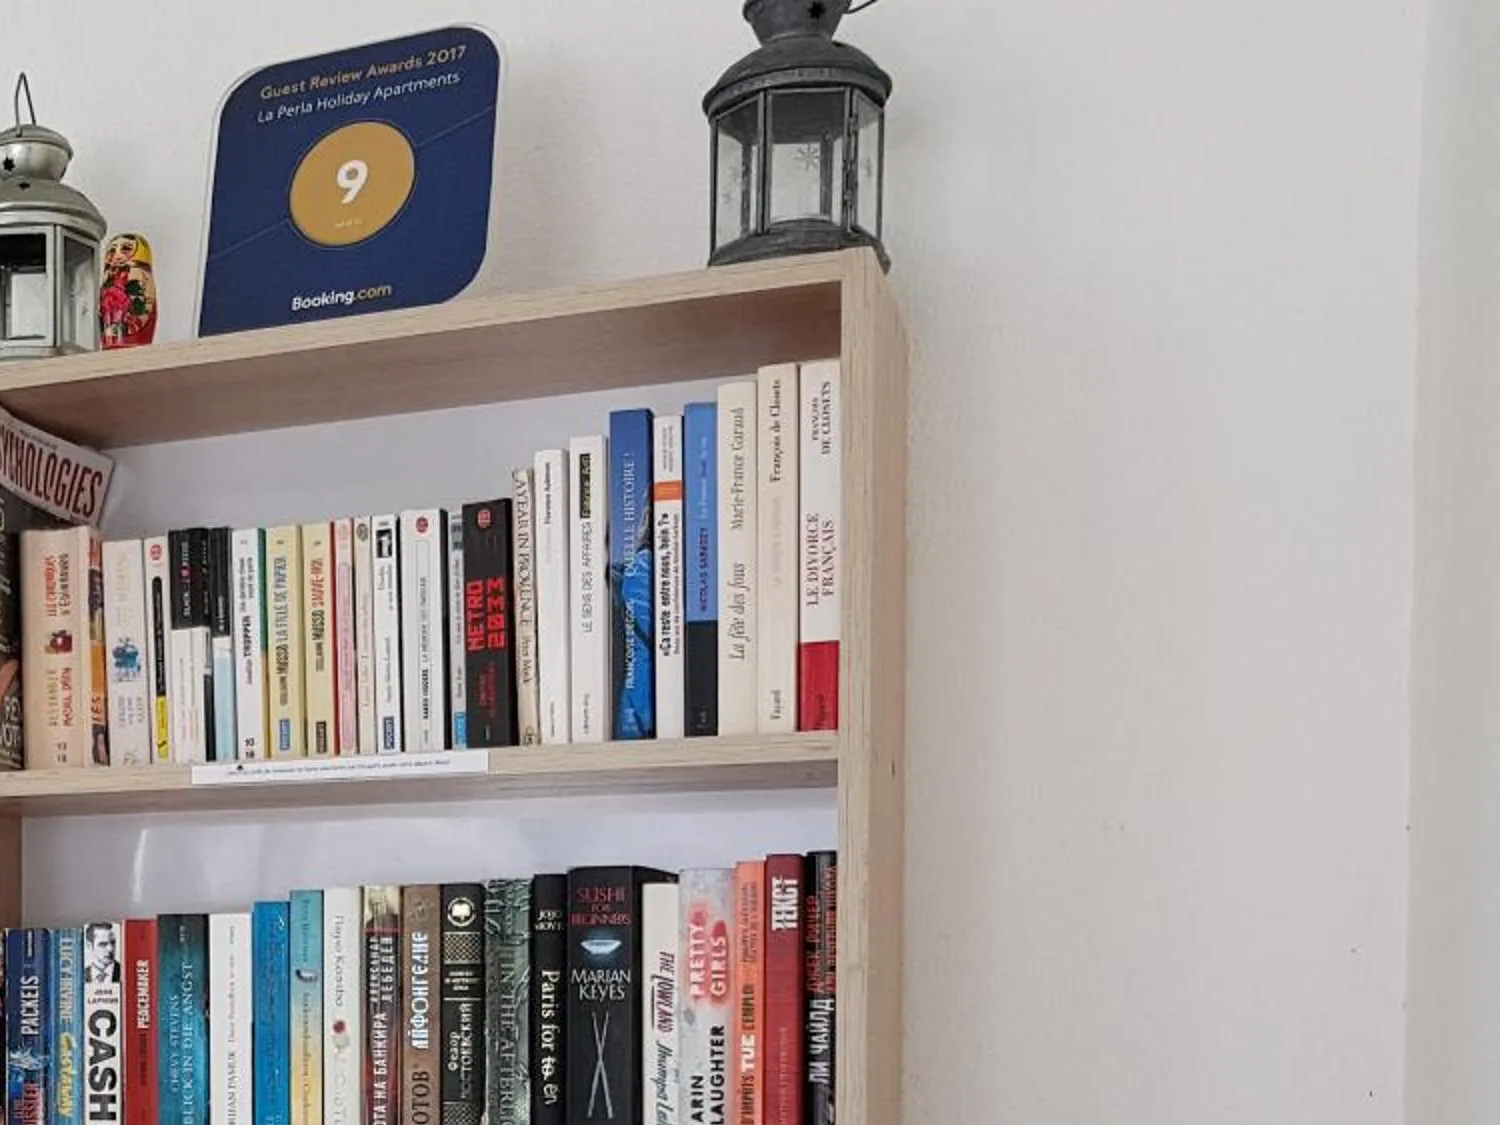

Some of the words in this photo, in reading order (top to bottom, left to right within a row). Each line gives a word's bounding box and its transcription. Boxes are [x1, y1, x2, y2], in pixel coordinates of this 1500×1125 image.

[260, 81, 306, 101] Guest
[309, 69, 363, 90] Review
[367, 56, 423, 78] Awards
[426, 45, 467, 66] 2017
[258, 109, 273, 123] La
[277, 100, 313, 119] Perla
[317, 89, 371, 111] Holiday
[374, 71, 461, 101] Apartments
[336, 159, 368, 205] 9
[291, 284, 392, 311] Booking.com
[769, 378, 781, 418] Closets
[820, 380, 831, 436] CLOSETS
[729, 406, 745, 452] Garaud
[770, 420, 781, 433] de
[820, 437, 831, 455] DE
[769, 435, 784, 483] François
[515, 488, 529, 531] YEAR
[622, 461, 636, 521] HISTOIRE
[729, 454, 745, 531] Marie-France
[518, 531, 530, 550] IN
[580, 521, 592, 568] AFFAIRES
[622, 523, 638, 578] QUELLE
[658, 529, 671, 550] hein
[806, 512, 820, 582] DIVORCE
[821, 519, 836, 598] FRANÇAIS
[581, 571, 592, 591] DES
[660, 550, 673, 579] nous,
[728, 562, 751, 592] fous
[487, 576, 506, 650] 2033
[581, 592, 592, 619] SENS
[659, 579, 672, 607] entre
[728, 593, 744, 615] des
[806, 583, 820, 607] LE
[242, 615, 253, 658] TROPPER
[312, 609, 325, 641] MUSSO
[466, 579, 485, 651] METRO
[581, 621, 592, 634] LE
[659, 609, 672, 636] reste
[728, 615, 751, 641] fête
[276, 643, 289, 675] MUSSO
[625, 635, 638, 690] FRANÇOISE
[729, 641, 745, 661] La
[576, 886, 627, 902] SUSHI
[591, 903, 612, 912] FOR
[771, 876, 799, 931] ТЕКСТ
[571, 912, 631, 926] BEGINNERS
[380, 936, 394, 1002] ЛЕБЕДЕВ
[501, 963, 515, 983] IN
[571, 969, 631, 984] MARIAN
[659, 951, 675, 972] THE
[689, 921, 705, 996] PRETTY
[711, 935, 727, 997] GIRLS
[20, 975, 39, 1036] PACKEIS
[180, 961, 193, 1016] ANGST
[541, 969, 560, 1018] Paris
[579, 985, 625, 1000] KEYES
[650, 974, 674, 1034] LOWLAND
[739, 983, 756, 1031] L'EMPLOI
[169, 994, 179, 1048] STEVENS
[500, 993, 514, 1031] THE
[808, 998, 835, 1055] ЧАЙЛД
[181, 1020, 193, 1048] DIE
[372, 1012, 387, 1075] БАНКИРА
[541, 1023, 560, 1050] for
[740, 1033, 756, 1073] TUE
[88, 1009, 117, 1121] CASH
[170, 1050, 180, 1093] CHEVY
[181, 1054, 194, 1075] IN
[650, 1040, 673, 1100] Jhumpa
[809, 1061, 829, 1084] ЛИ
[181, 1078, 195, 1125] BLICK
[373, 1080, 387, 1099] НА
[738, 1075, 755, 1125] D'IMPÔTS
